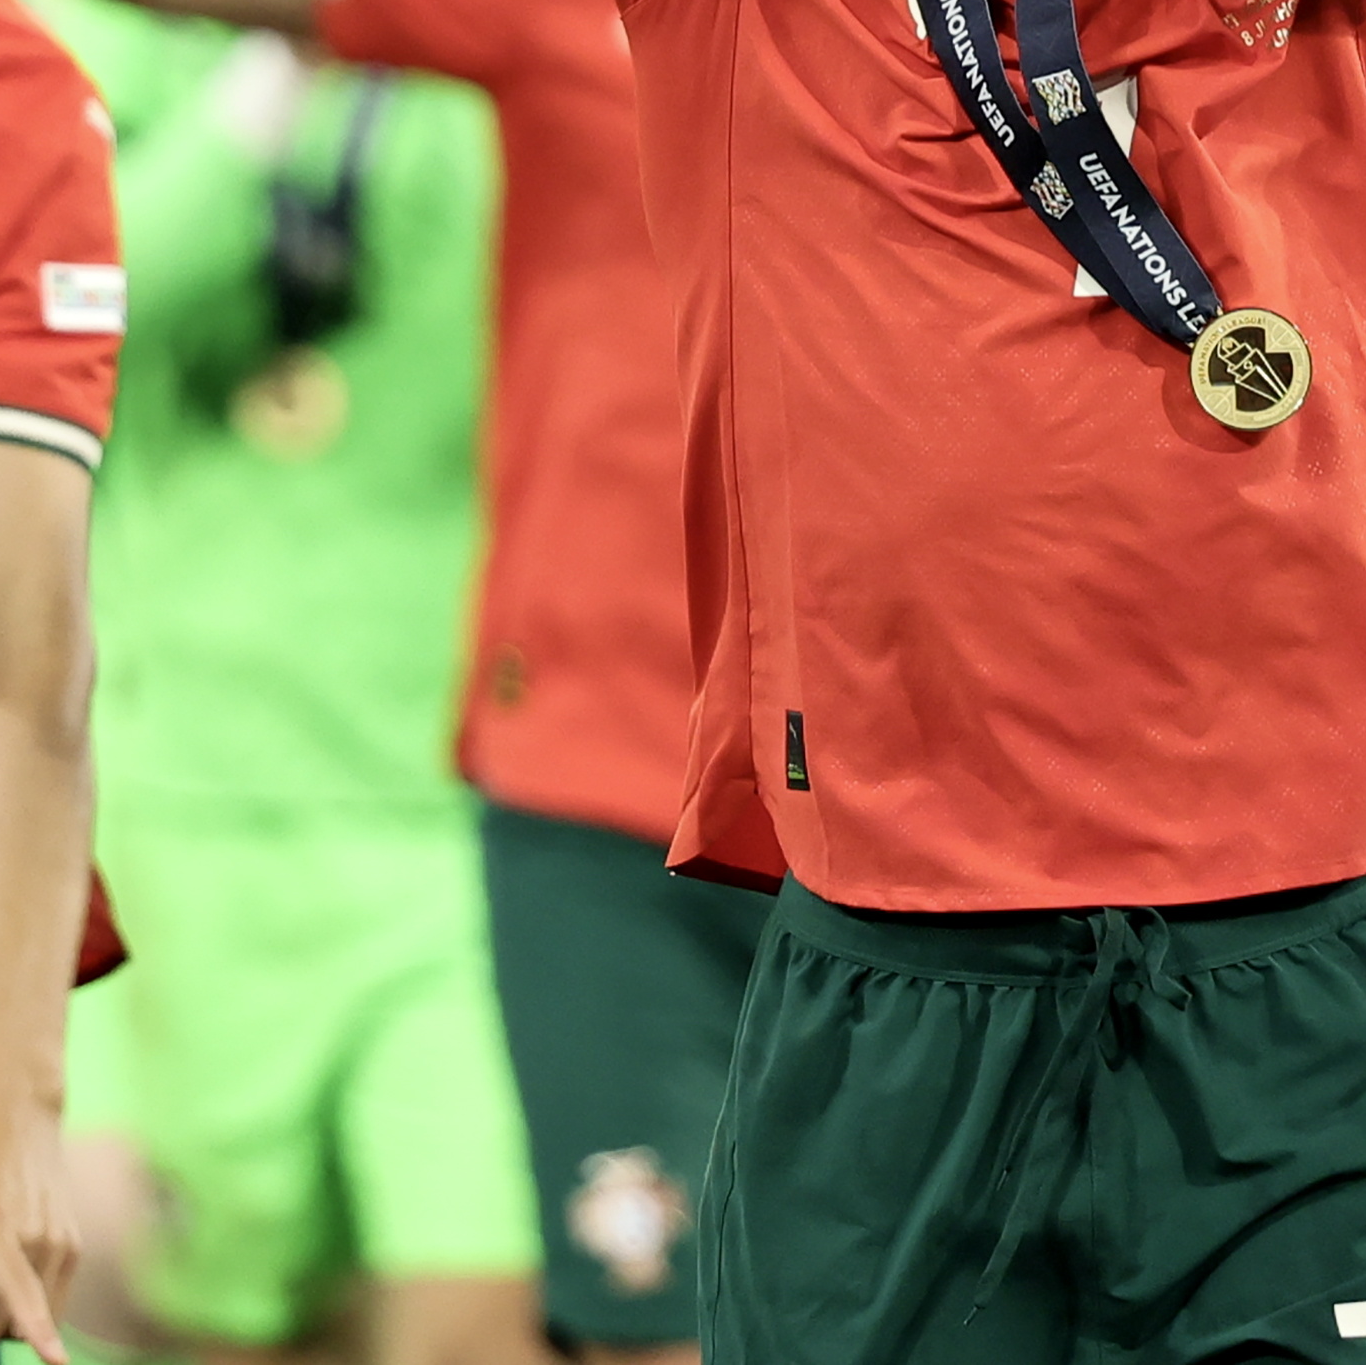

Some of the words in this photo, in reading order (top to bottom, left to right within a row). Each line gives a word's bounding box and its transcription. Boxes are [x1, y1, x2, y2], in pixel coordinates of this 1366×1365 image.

[977, 82, 1015, 148] UEFA
[1079, 152, 1122, 211] UEFA
[1110, 204, 1187, 307] NATIONS
